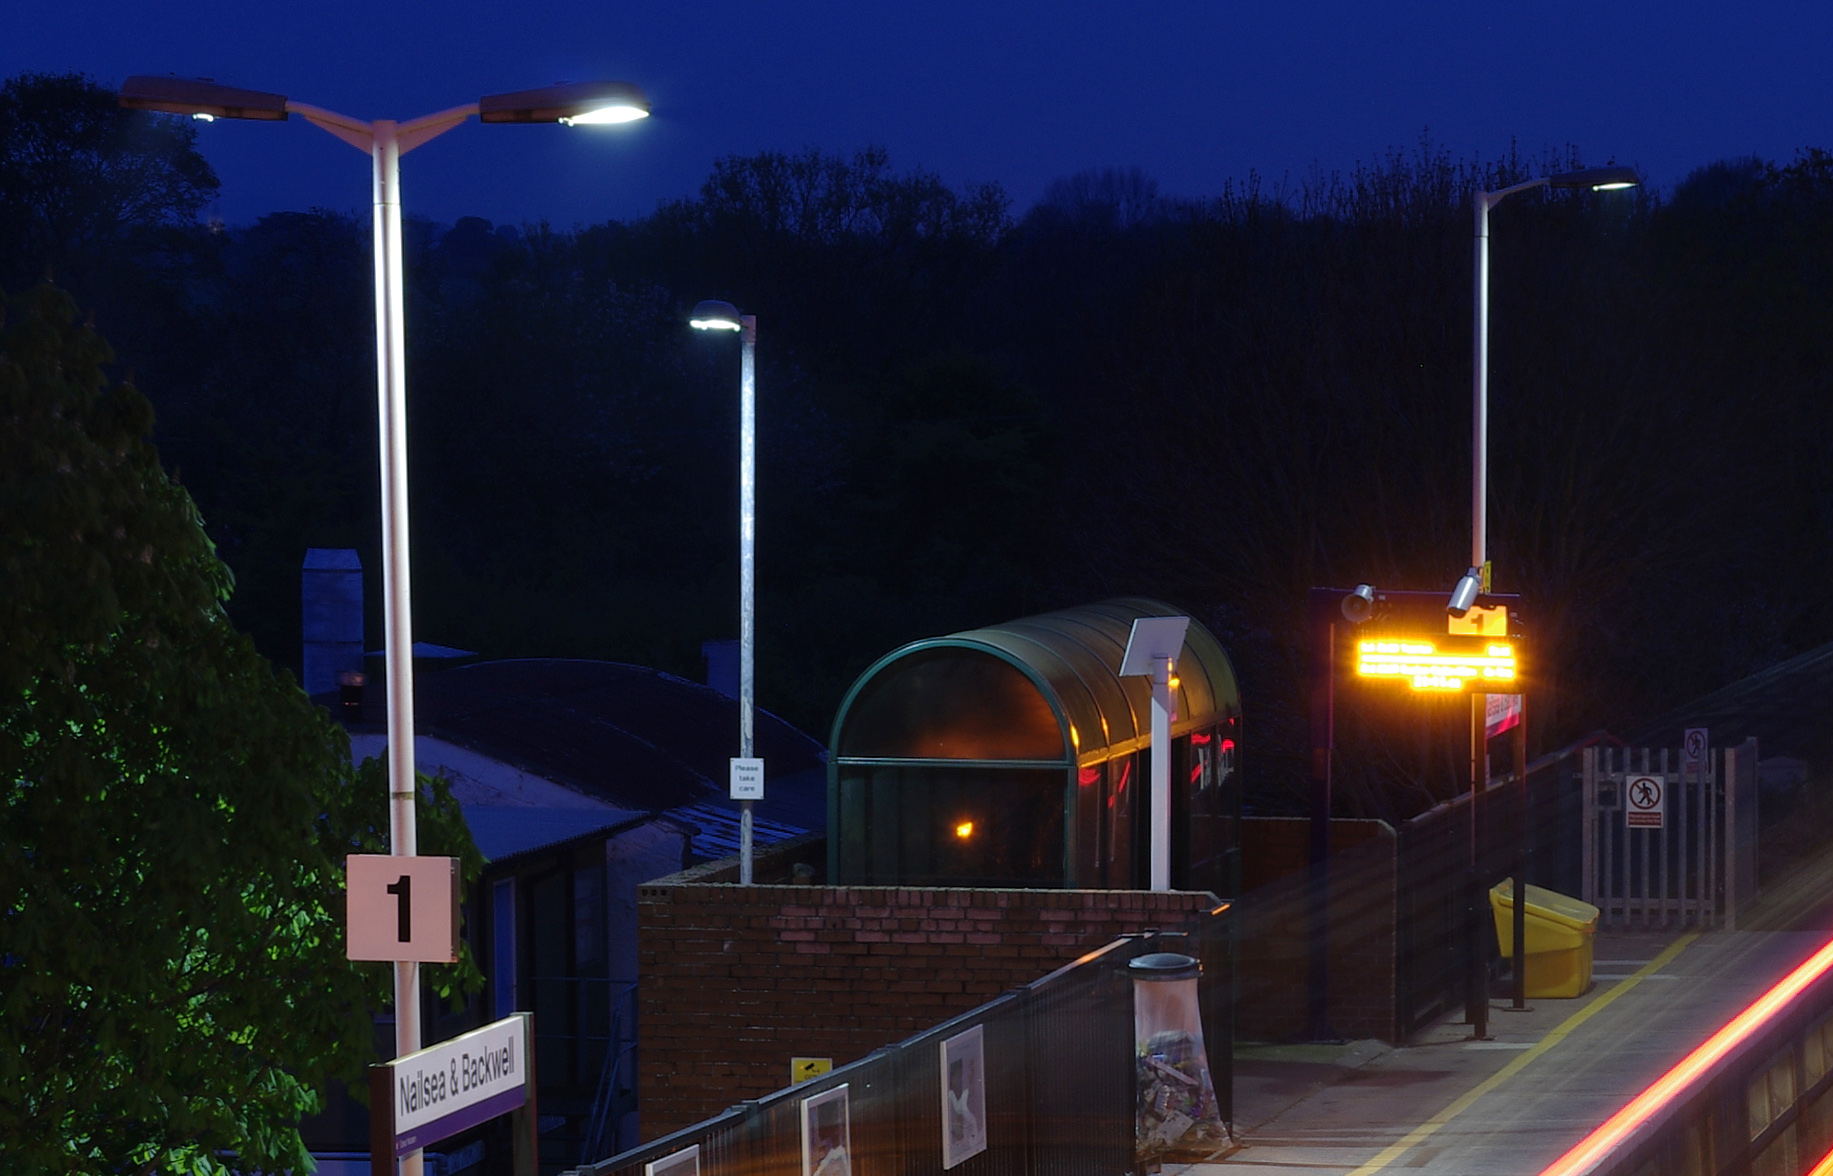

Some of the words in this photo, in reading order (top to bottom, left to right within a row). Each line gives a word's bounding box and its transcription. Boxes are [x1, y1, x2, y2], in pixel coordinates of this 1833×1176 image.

[1470, 613, 1484, 635] 1
[735, 764, 759, 772] Please
[387, 874, 412, 943] 1
[400, 1069, 447, 1117] Nailsea
[450, 1057, 459, 1097] &
[462, 1035, 515, 1092] Backwell
